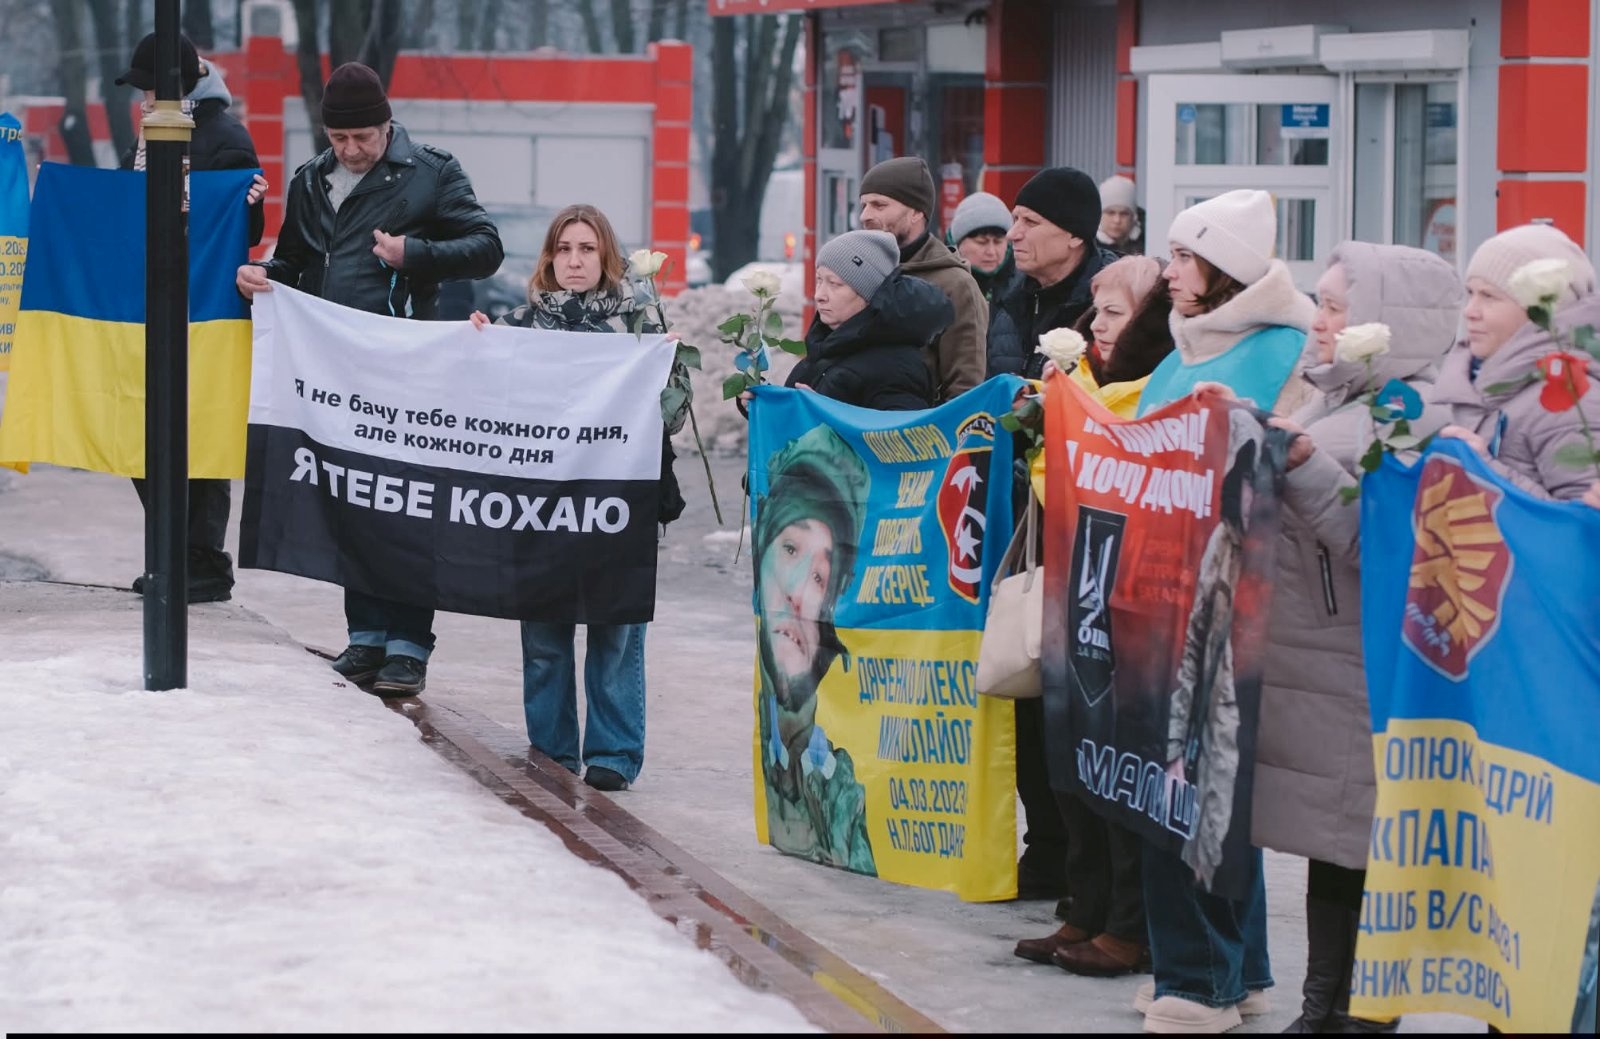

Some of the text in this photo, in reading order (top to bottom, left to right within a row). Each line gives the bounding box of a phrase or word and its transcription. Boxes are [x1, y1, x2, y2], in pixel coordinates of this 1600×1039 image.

[294, 378, 629, 444] Я не бачу тебе кожного дня,
[354, 423, 554, 465] але кожного дня
[289, 447, 630, 534] Я ТЕБЕ КОХАЮ
